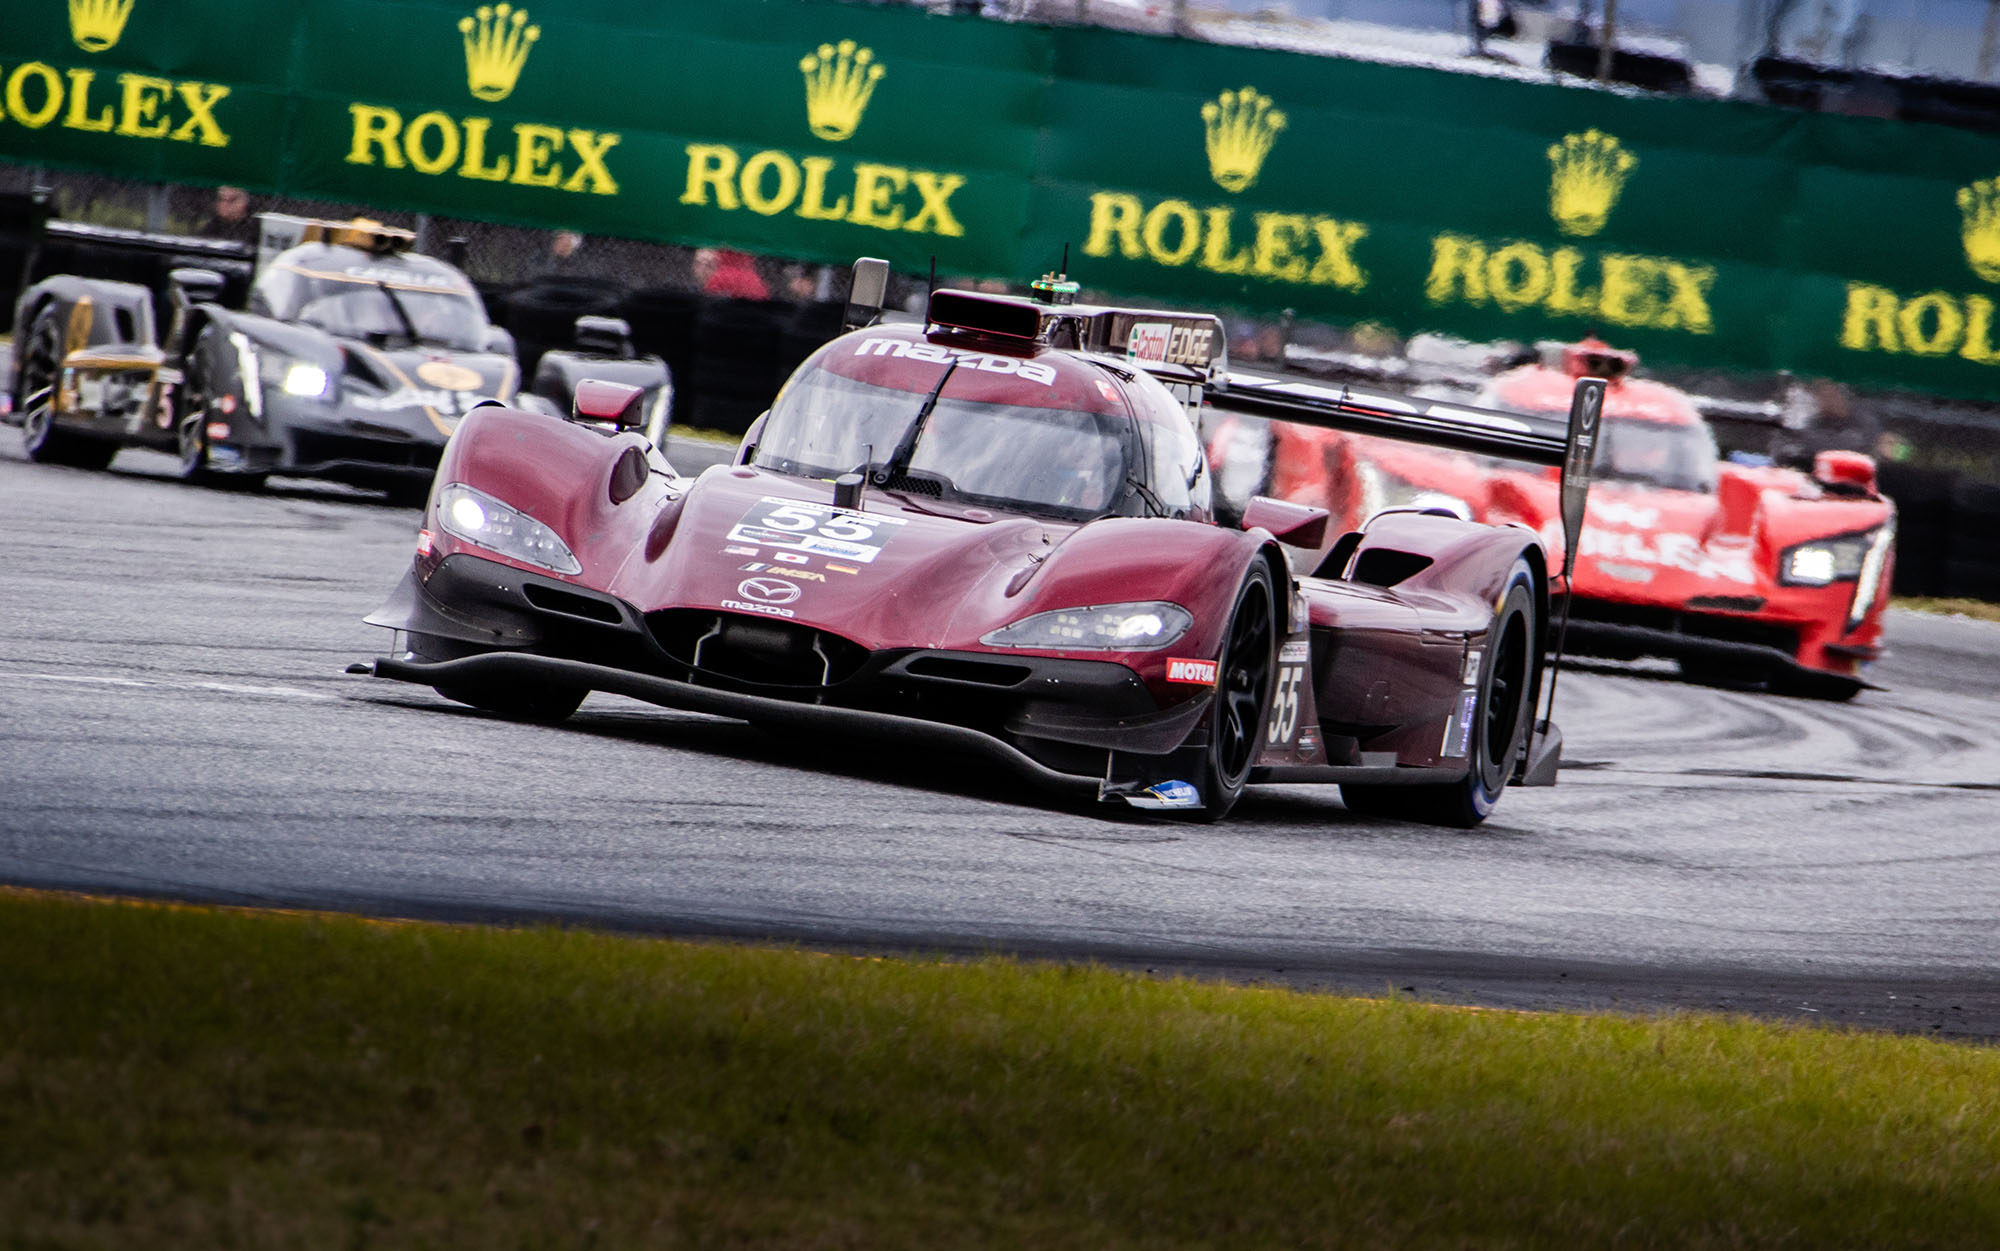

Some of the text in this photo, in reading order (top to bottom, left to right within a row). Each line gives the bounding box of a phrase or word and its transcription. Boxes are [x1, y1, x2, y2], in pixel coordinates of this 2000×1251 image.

[0, 62, 230, 148] OLEX
[346, 103, 620, 195] ROLEX
[679, 144, 965, 237] ROLEX
[1083, 191, 1368, 290] ROLEX
[1426, 232, 1716, 334] ROLEX
[1136, 326, 1214, 366] Castrol EDGE
[761, 505, 881, 542] 55
[766, 566, 826, 583] IMSA
[1168, 661, 1216, 682] MOTUL
[1268, 666, 1303, 744] 55
